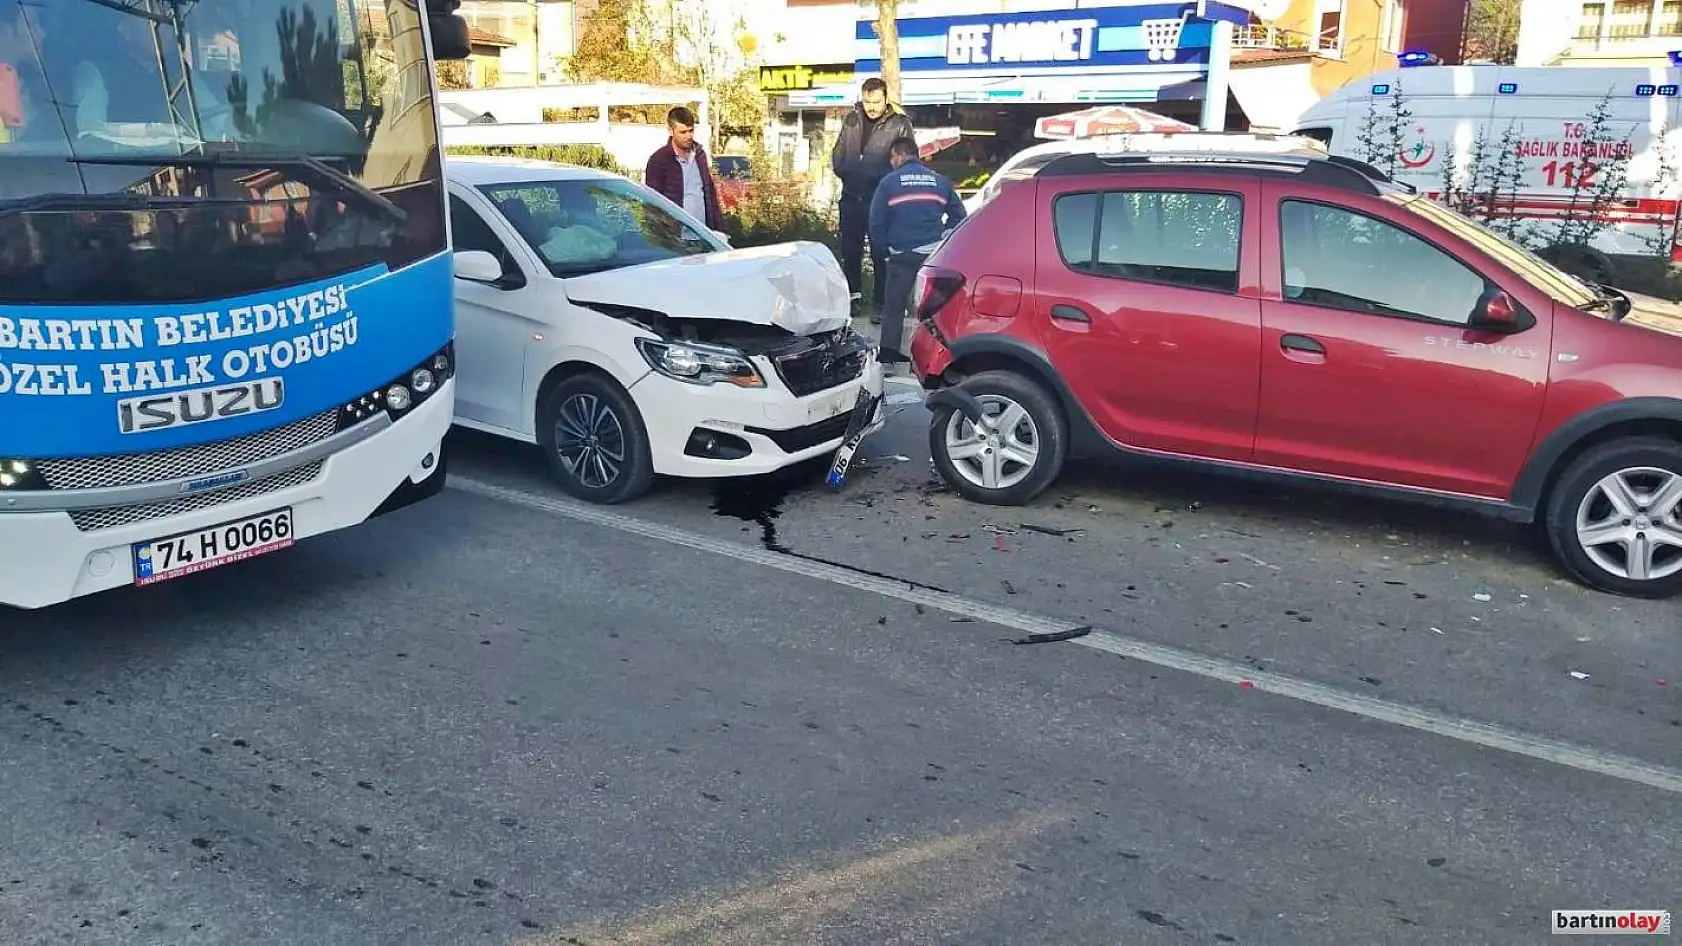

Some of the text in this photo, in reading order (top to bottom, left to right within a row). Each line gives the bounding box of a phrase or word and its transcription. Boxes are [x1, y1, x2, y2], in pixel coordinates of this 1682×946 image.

[1542, 160, 1598, 188] 112
[0, 316, 144, 350] BARTIN
[1424, 336, 1539, 359] STEPWAY
[100, 354, 215, 393] HALK
[222, 310, 359, 378] OTOBÜSÜ
[121, 379, 283, 433] ISUZU
[834, 458, 848, 476] 06
[157, 539, 193, 568] 74
[200, 531, 217, 558] H
[225, 514, 289, 551] 0066
